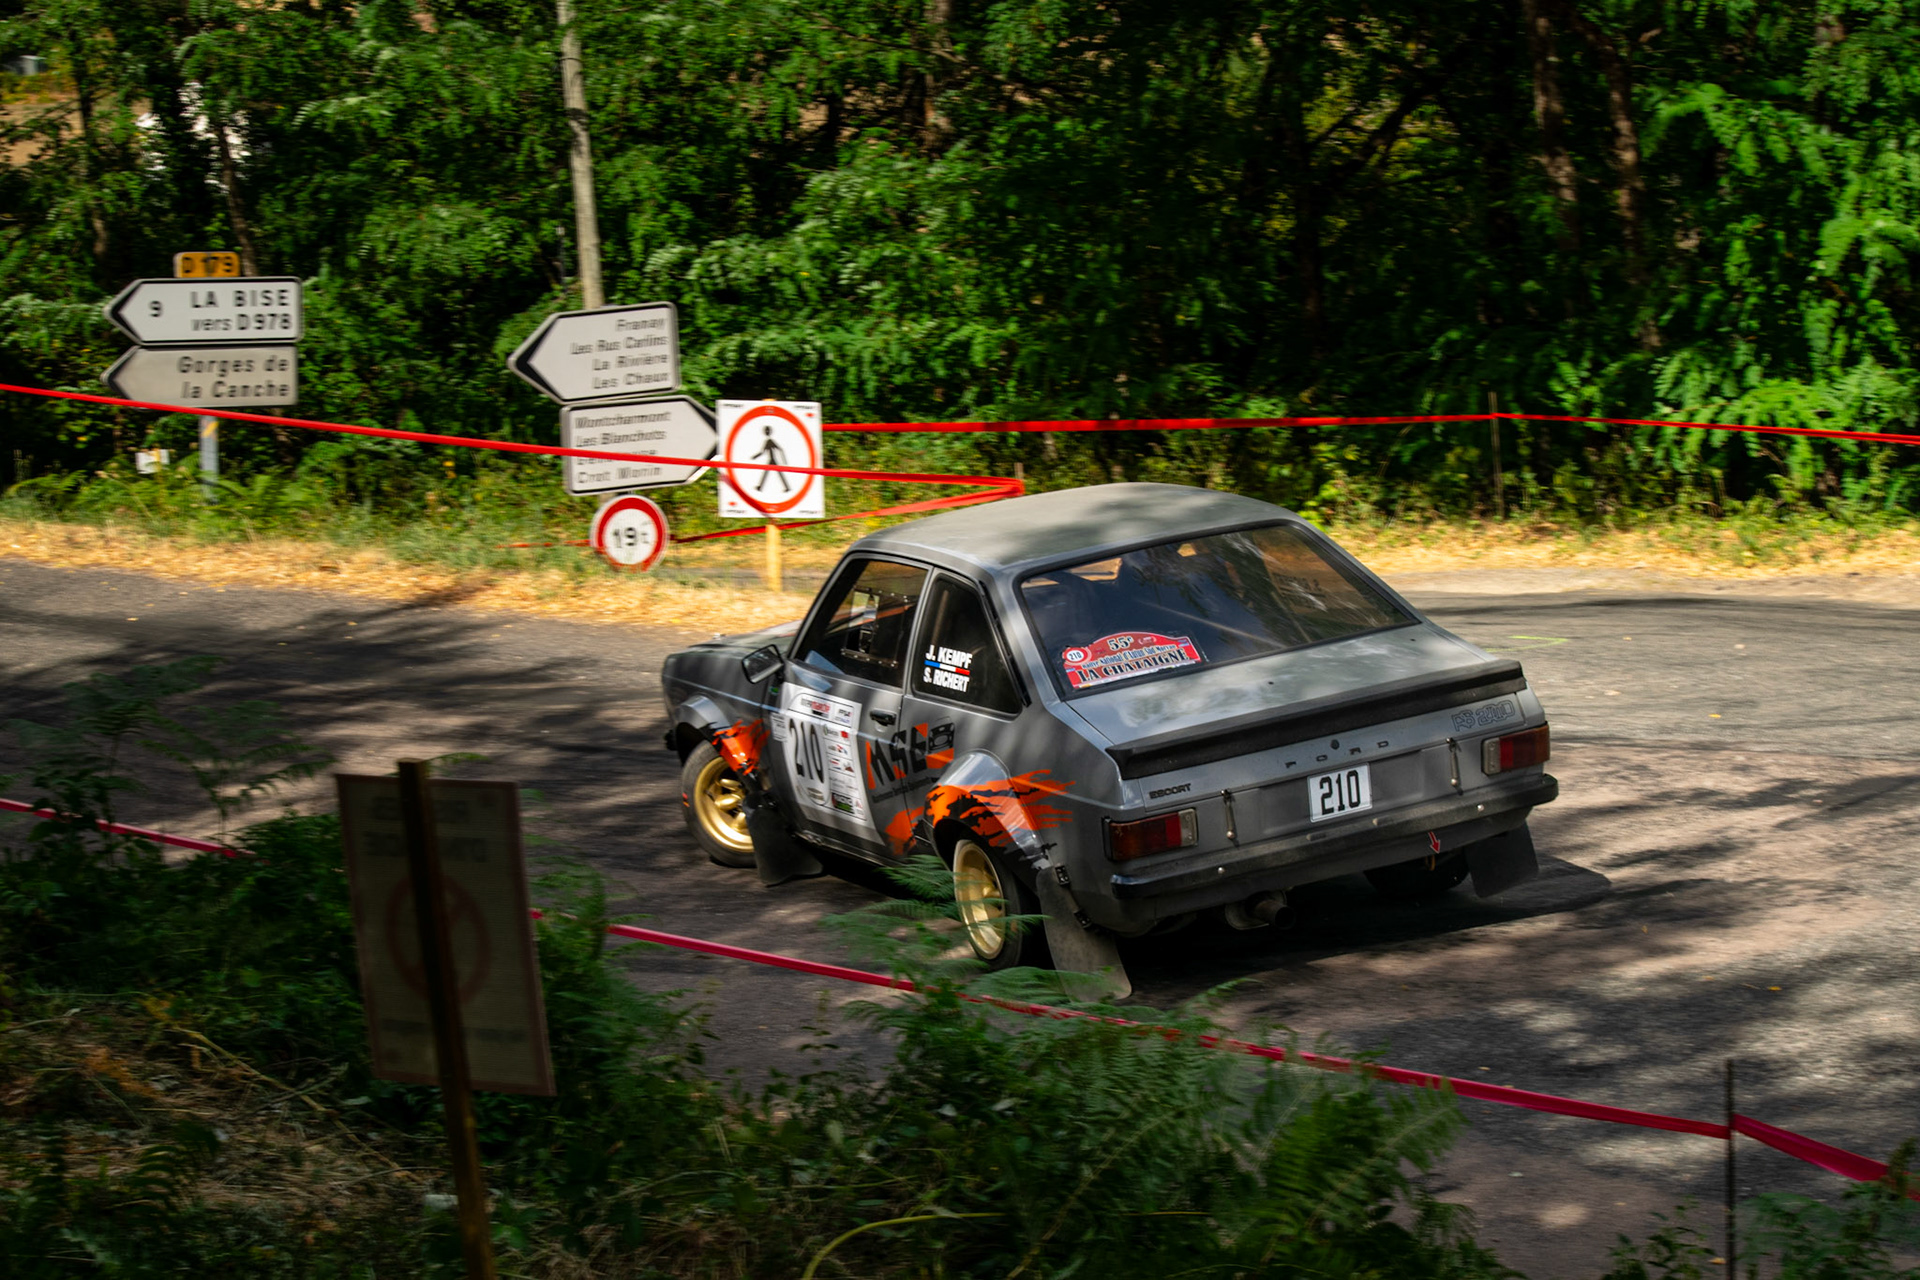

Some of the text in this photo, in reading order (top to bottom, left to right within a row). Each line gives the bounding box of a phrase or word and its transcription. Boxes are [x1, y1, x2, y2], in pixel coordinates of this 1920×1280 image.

[190, 289, 290, 309] LA BISE
[148, 300, 164, 318] 9
[191, 318, 232, 331] vers
[177, 355, 290, 377] Gorges de
[592, 358, 610, 372] La
[180, 380, 290, 399] la Canche
[592, 376, 618, 390] Les
[576, 433, 598, 447] Les
[925, 644, 972, 669] J. KEMPF
[1069, 651, 1082, 660] 210
[923, 668, 970, 692] S. RICHERT
[1076, 668, 1101, 683] LA
[789, 717, 824, 784] 210
[1286, 740, 1389, 769] FORD
[1149, 783, 1191, 799] ESCORT
[1319, 769, 1361, 816] 210
